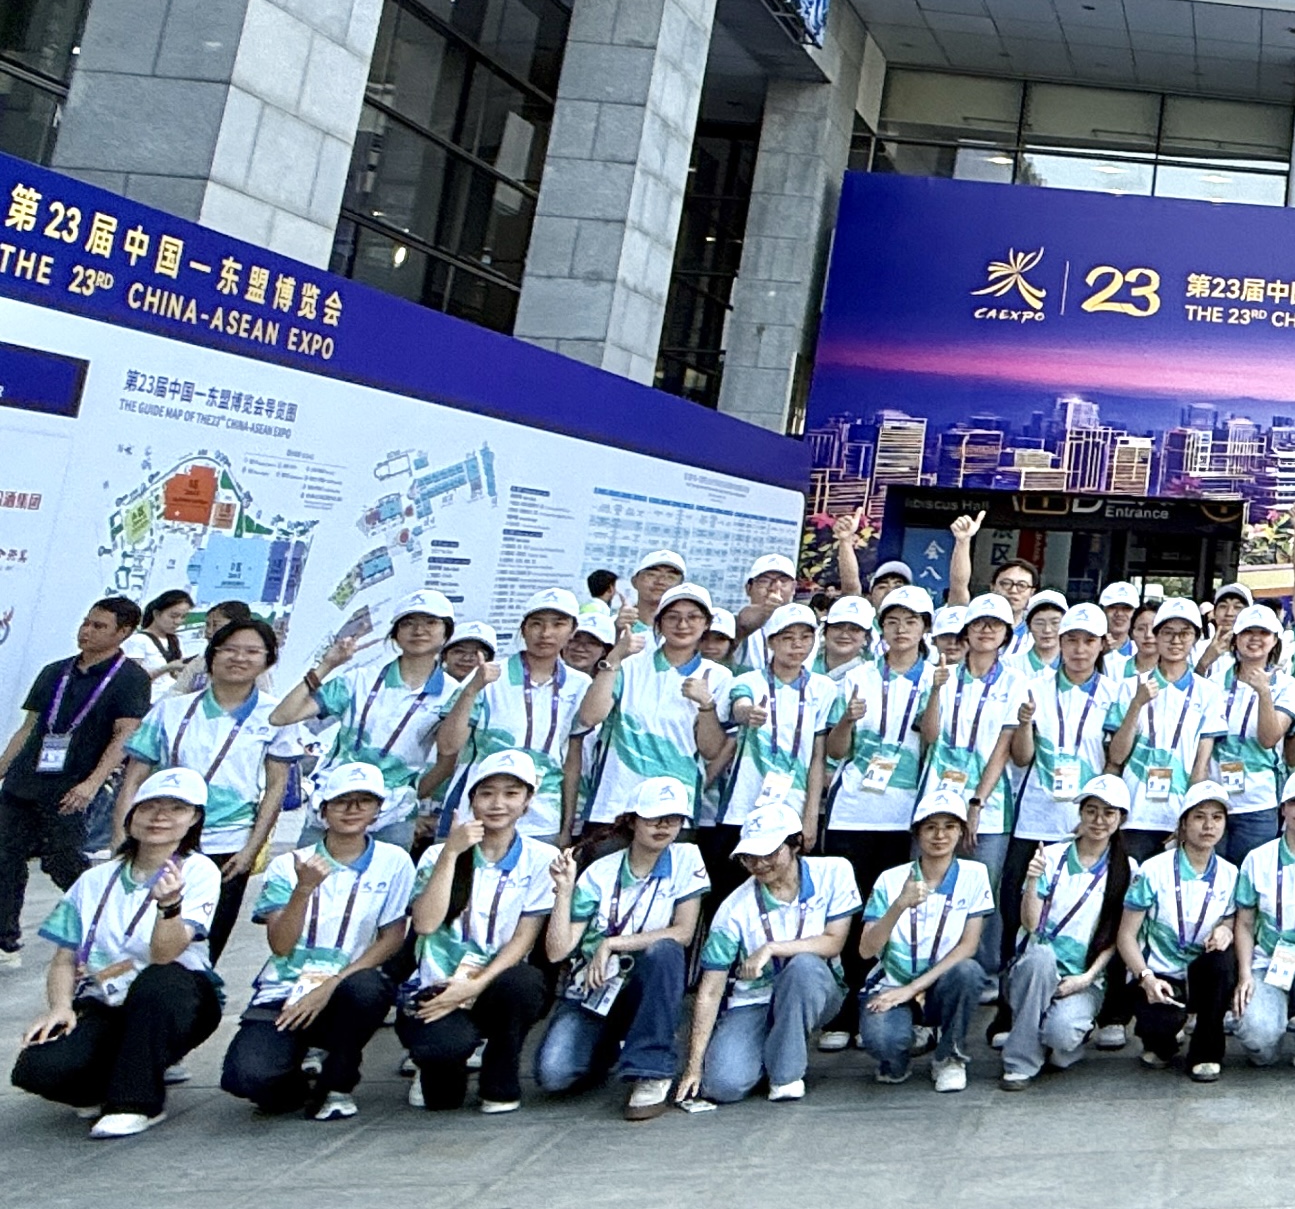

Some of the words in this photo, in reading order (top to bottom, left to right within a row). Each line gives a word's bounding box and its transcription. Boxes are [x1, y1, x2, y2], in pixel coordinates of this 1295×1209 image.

[0, 244, 54, 285] THE
[68, 264, 115, 296] 23RD
[127, 282, 280, 346] CHINA-ASEAN
[287, 326, 335, 360] EXPO
[1080, 265, 1161, 318] 23
[1185, 304, 1224, 323] THE
[1227, 307, 1267, 325] 23RD
[119, 398, 138, 413] THE
[138, 401, 166, 418] GUIDE
[165, 407, 184, 421] MAP
[184, 410, 196, 422] OF
[226, 417, 273, 436] CHINA-ASEAN
[273, 425, 292, 440] EXPO
[1104, 504, 1170, 520] Entrance
